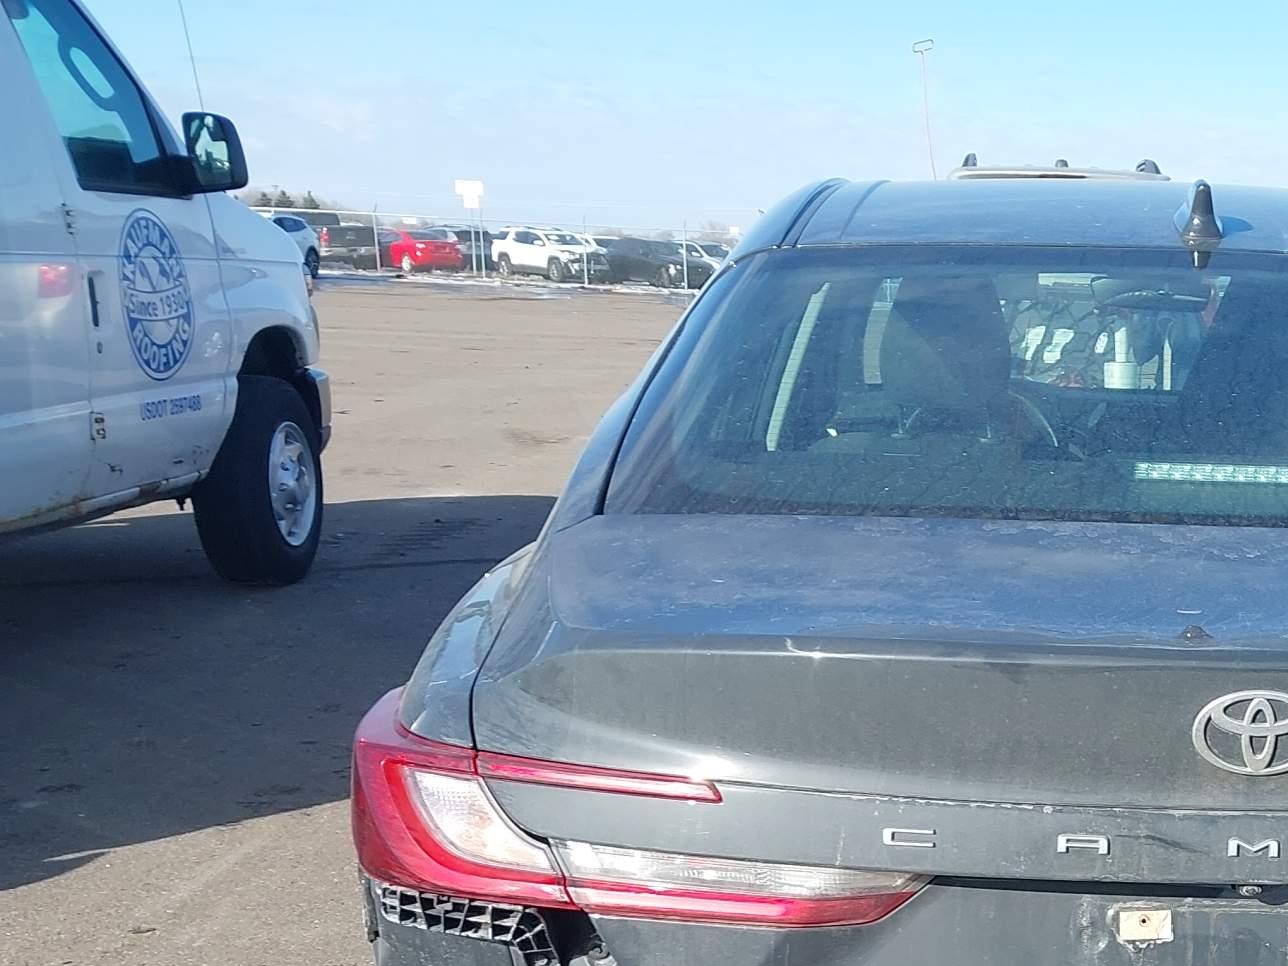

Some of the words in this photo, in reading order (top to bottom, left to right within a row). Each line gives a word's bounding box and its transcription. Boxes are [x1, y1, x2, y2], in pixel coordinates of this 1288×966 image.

[122, 218, 185, 284] KAUFMAN
[129, 292, 158, 317] Since
[160, 289, 186, 314] 1930
[132, 318, 189, 371] ROOFING
[141, 399, 168, 421] USDOT
